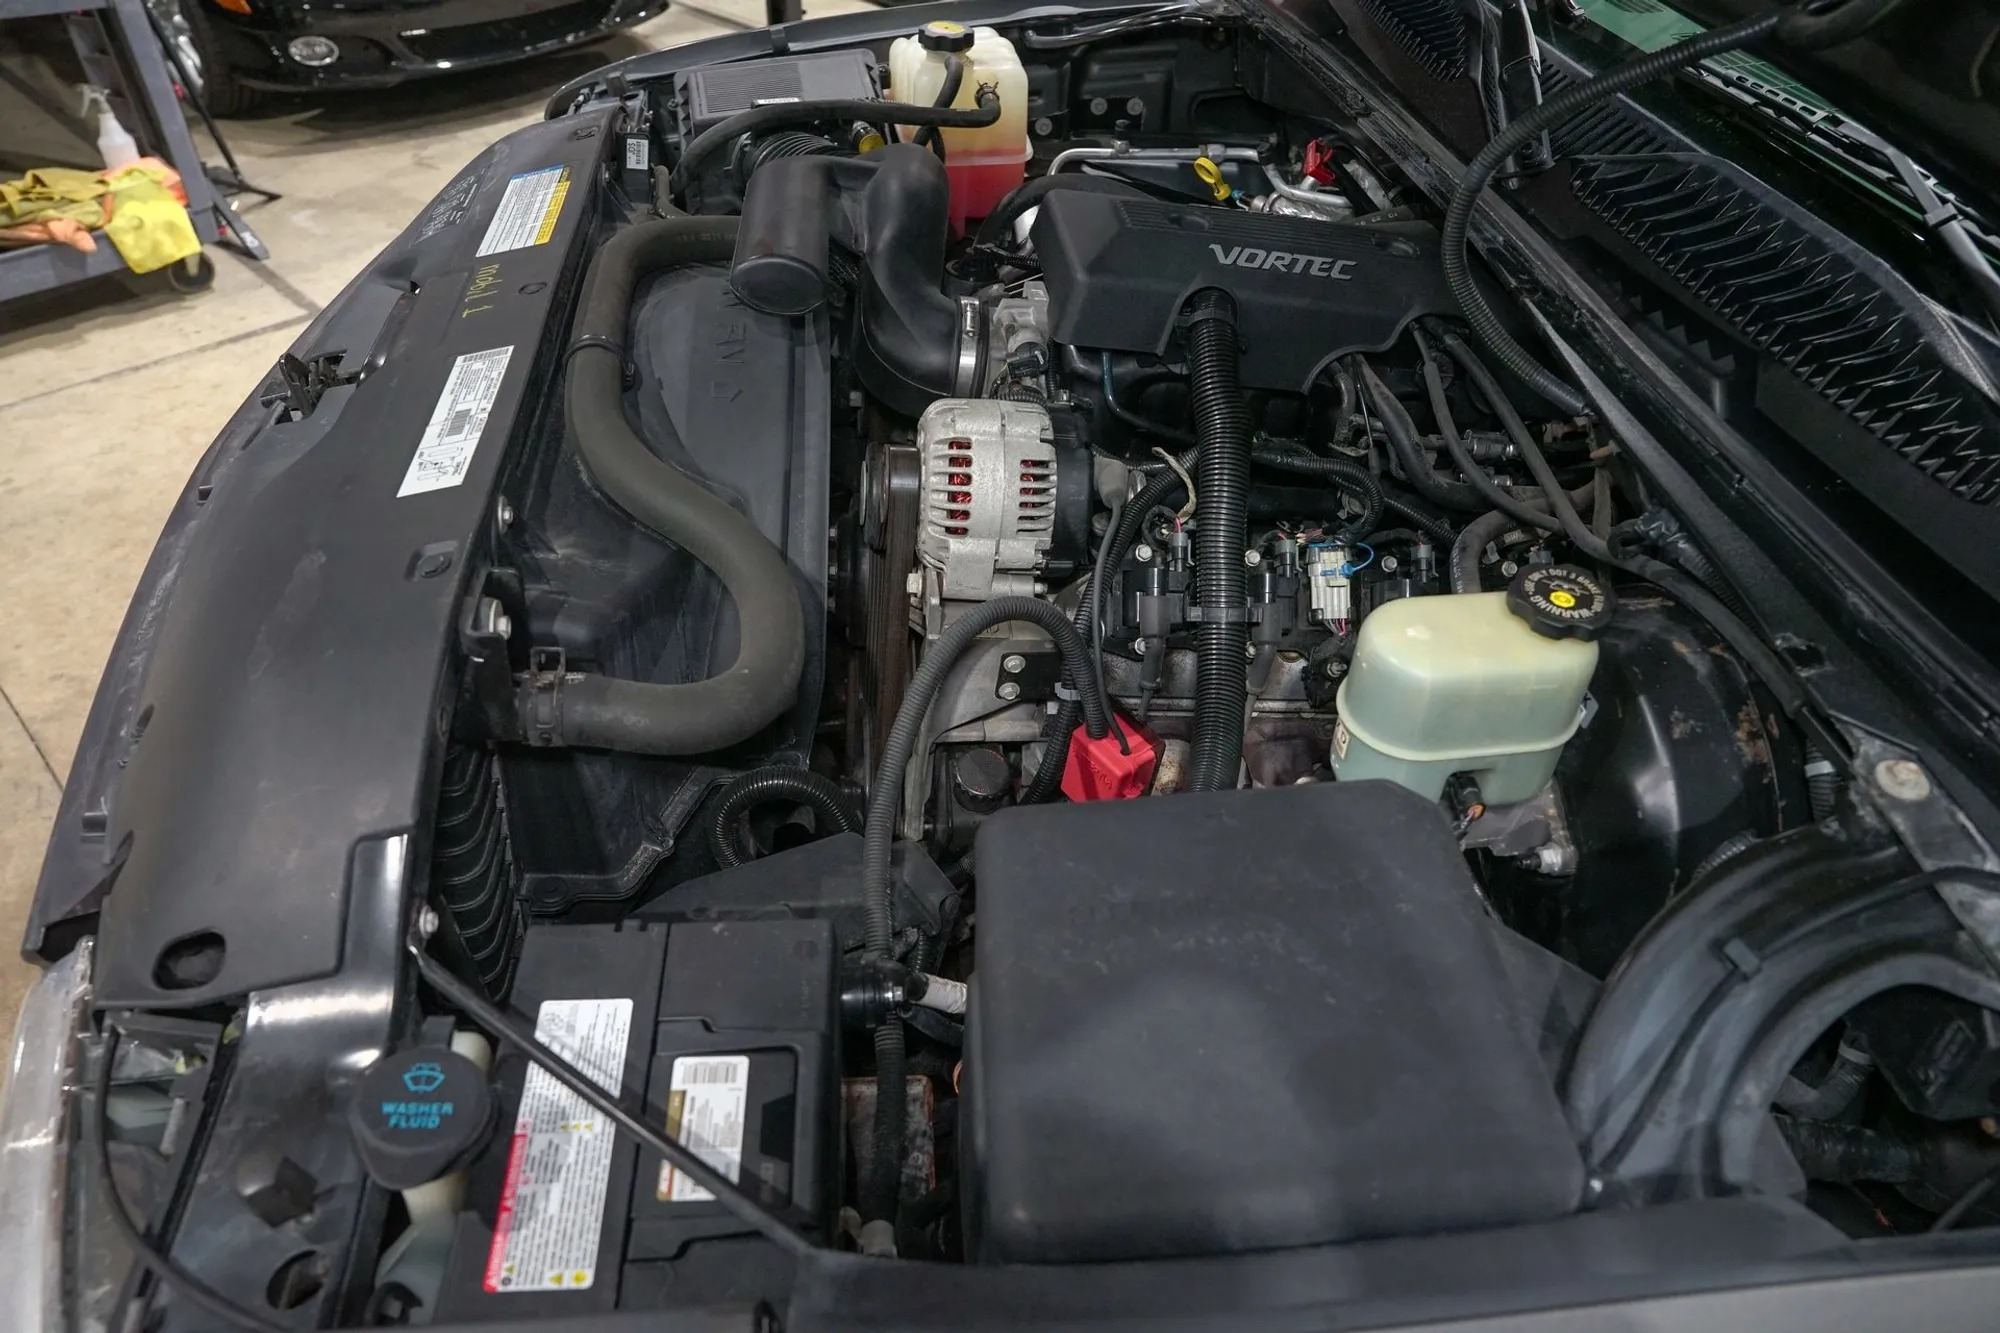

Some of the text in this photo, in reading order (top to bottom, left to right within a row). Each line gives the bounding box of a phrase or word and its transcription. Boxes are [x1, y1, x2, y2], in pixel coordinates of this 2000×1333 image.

[1208, 243, 1358, 282] VORTEC
[1548, 567, 1568, 578] DOT
[1576, 575, 1602, 595] BRAKE
[1529, 594, 1596, 619] WARNING
[382, 1101, 455, 1117] WASHER
[387, 1113, 441, 1129] FLUID
